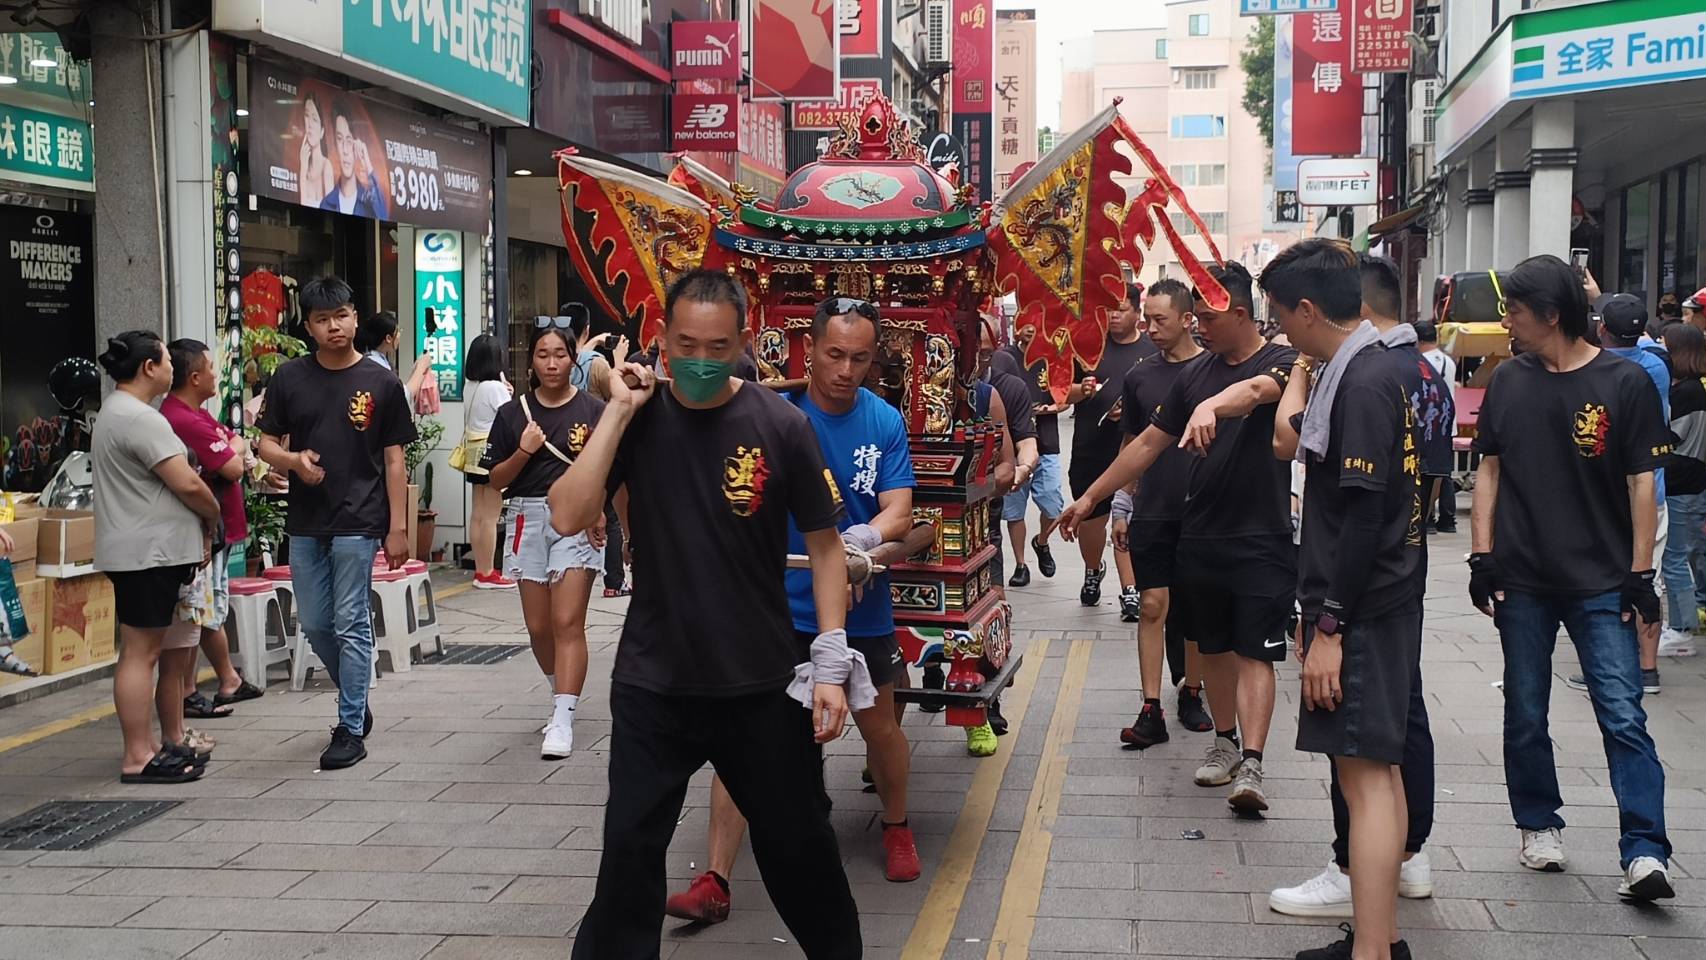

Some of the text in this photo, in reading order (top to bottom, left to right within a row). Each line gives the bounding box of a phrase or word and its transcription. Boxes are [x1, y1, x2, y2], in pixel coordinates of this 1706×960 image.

[1358, 31, 1410, 40] 31188
[1358, 41, 1409, 50] 325318
[676, 50, 723, 67] PUMA
[1312, 13, 1342, 93] 遠傳
[1358, 58, 1409, 68] 325318
[1557, 38, 1614, 76] 全家
[1001, 75, 1019, 155] 天下貢糖
[675, 130, 735, 140] new balance
[394, 166, 439, 211] 3,980
[1340, 180, 1370, 191] FET
[10, 240, 81, 264] DIFFERENCE
[21, 260, 72, 282] MAKERS
[850, 444, 883, 497] 特搜
